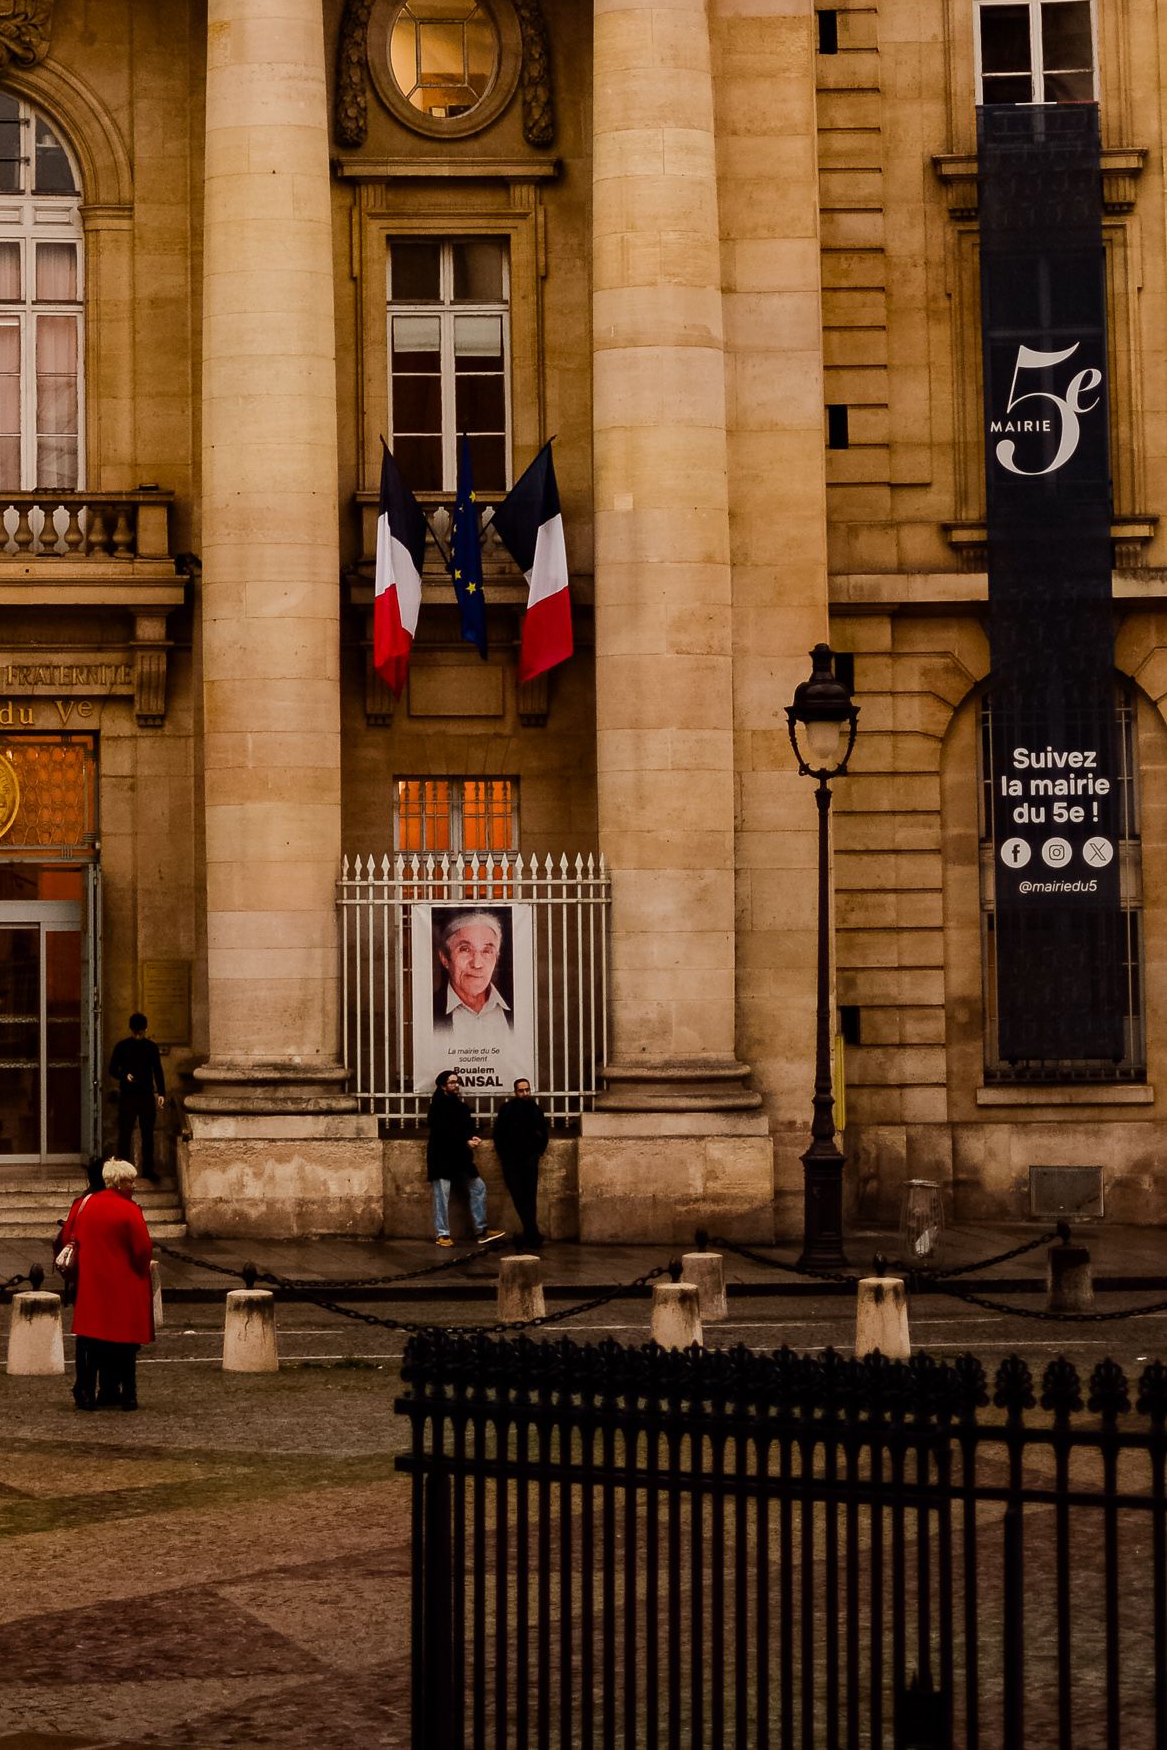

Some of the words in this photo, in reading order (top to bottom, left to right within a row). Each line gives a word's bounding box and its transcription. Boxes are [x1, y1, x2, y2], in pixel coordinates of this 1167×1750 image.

[990, 420, 1051, 433] MAIRIE
[1013, 746, 1097, 769] Suivez
[1001, 775, 1023, 796] la
[1030, 773, 1110, 796] mairie
[1013, 802, 1045, 823] du
[1053, 802, 1085, 823] 5e
[1019, 879, 1097, 894] @mairiedu5
[457, 1047, 479, 1055] mairie
[454, 1066, 495, 1074] Boualem
[457, 1075, 503, 1087] ANSAL
